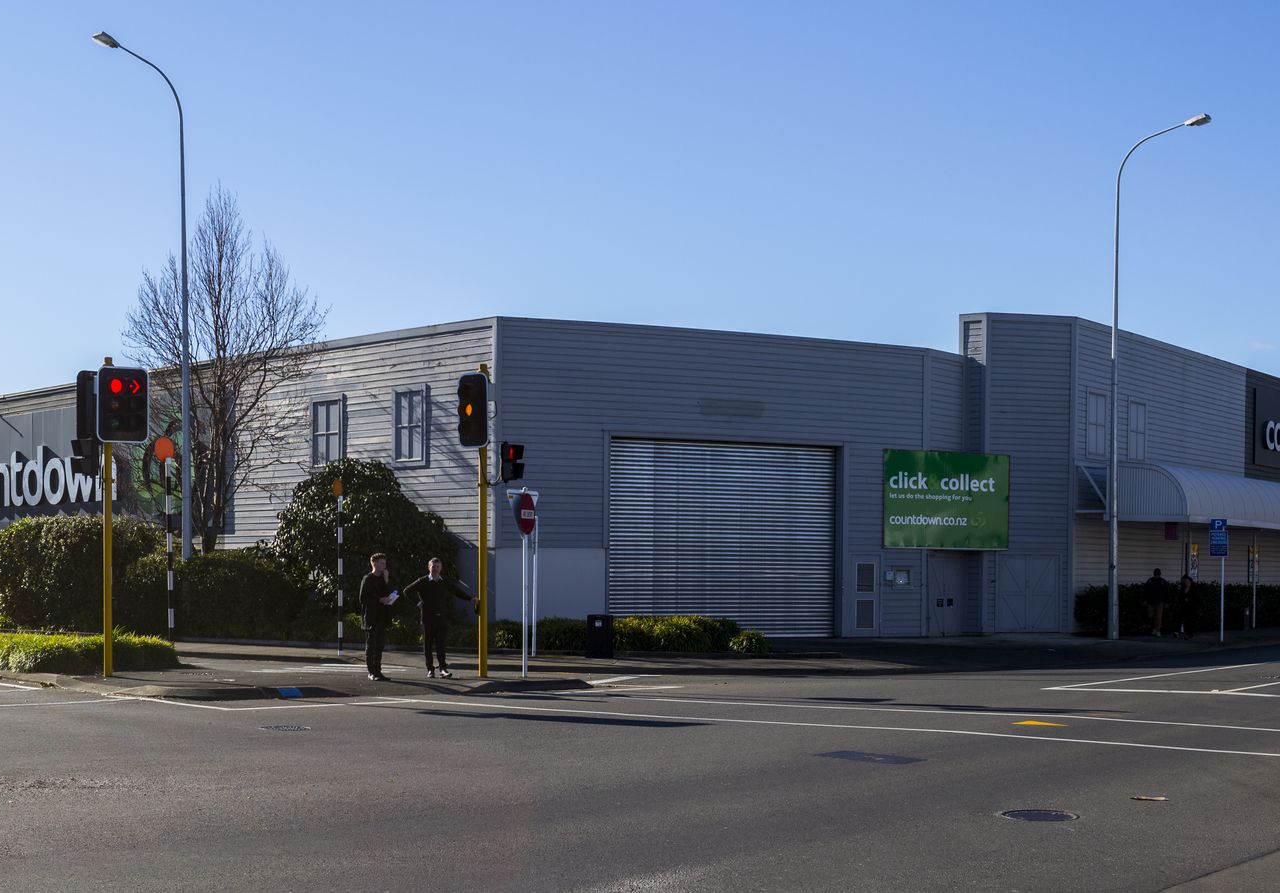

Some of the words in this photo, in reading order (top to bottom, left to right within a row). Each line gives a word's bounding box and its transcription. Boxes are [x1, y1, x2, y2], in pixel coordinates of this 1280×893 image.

[889, 471, 928, 489] click
[940, 474, 995, 492] collect
[925, 493, 952, 502] shopping
[889, 514, 968, 526] countdown.co.nz
[1215, 520, 1223, 529] P
